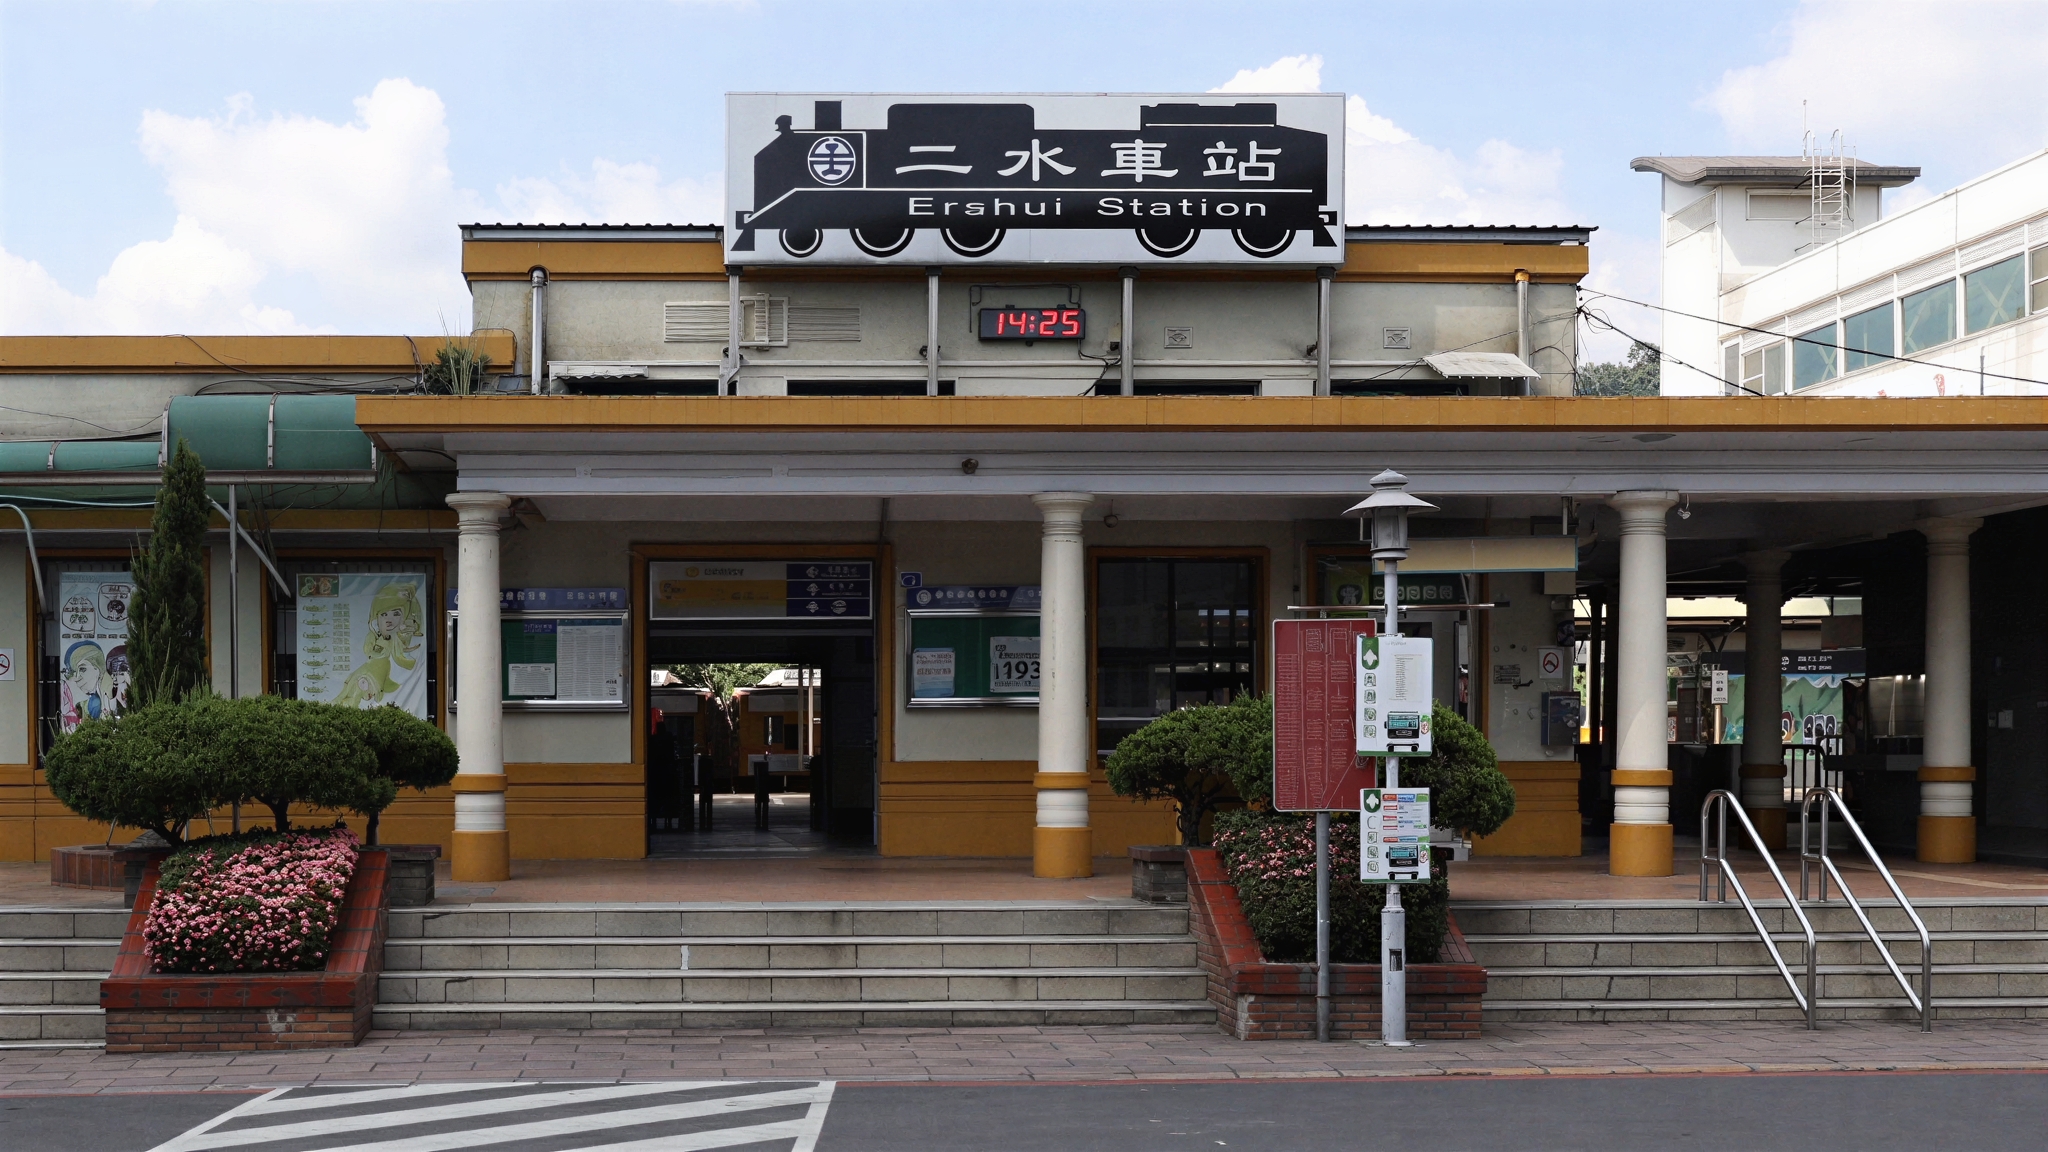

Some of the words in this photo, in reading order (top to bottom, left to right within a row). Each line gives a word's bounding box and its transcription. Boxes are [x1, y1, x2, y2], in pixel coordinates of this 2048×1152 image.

[896, 139, 1282, 182] 二水車站
[908, 197, 1062, 217] Ershui
[1098, 197, 1267, 217] Station
[996, 309, 1081, 336] 14:25
